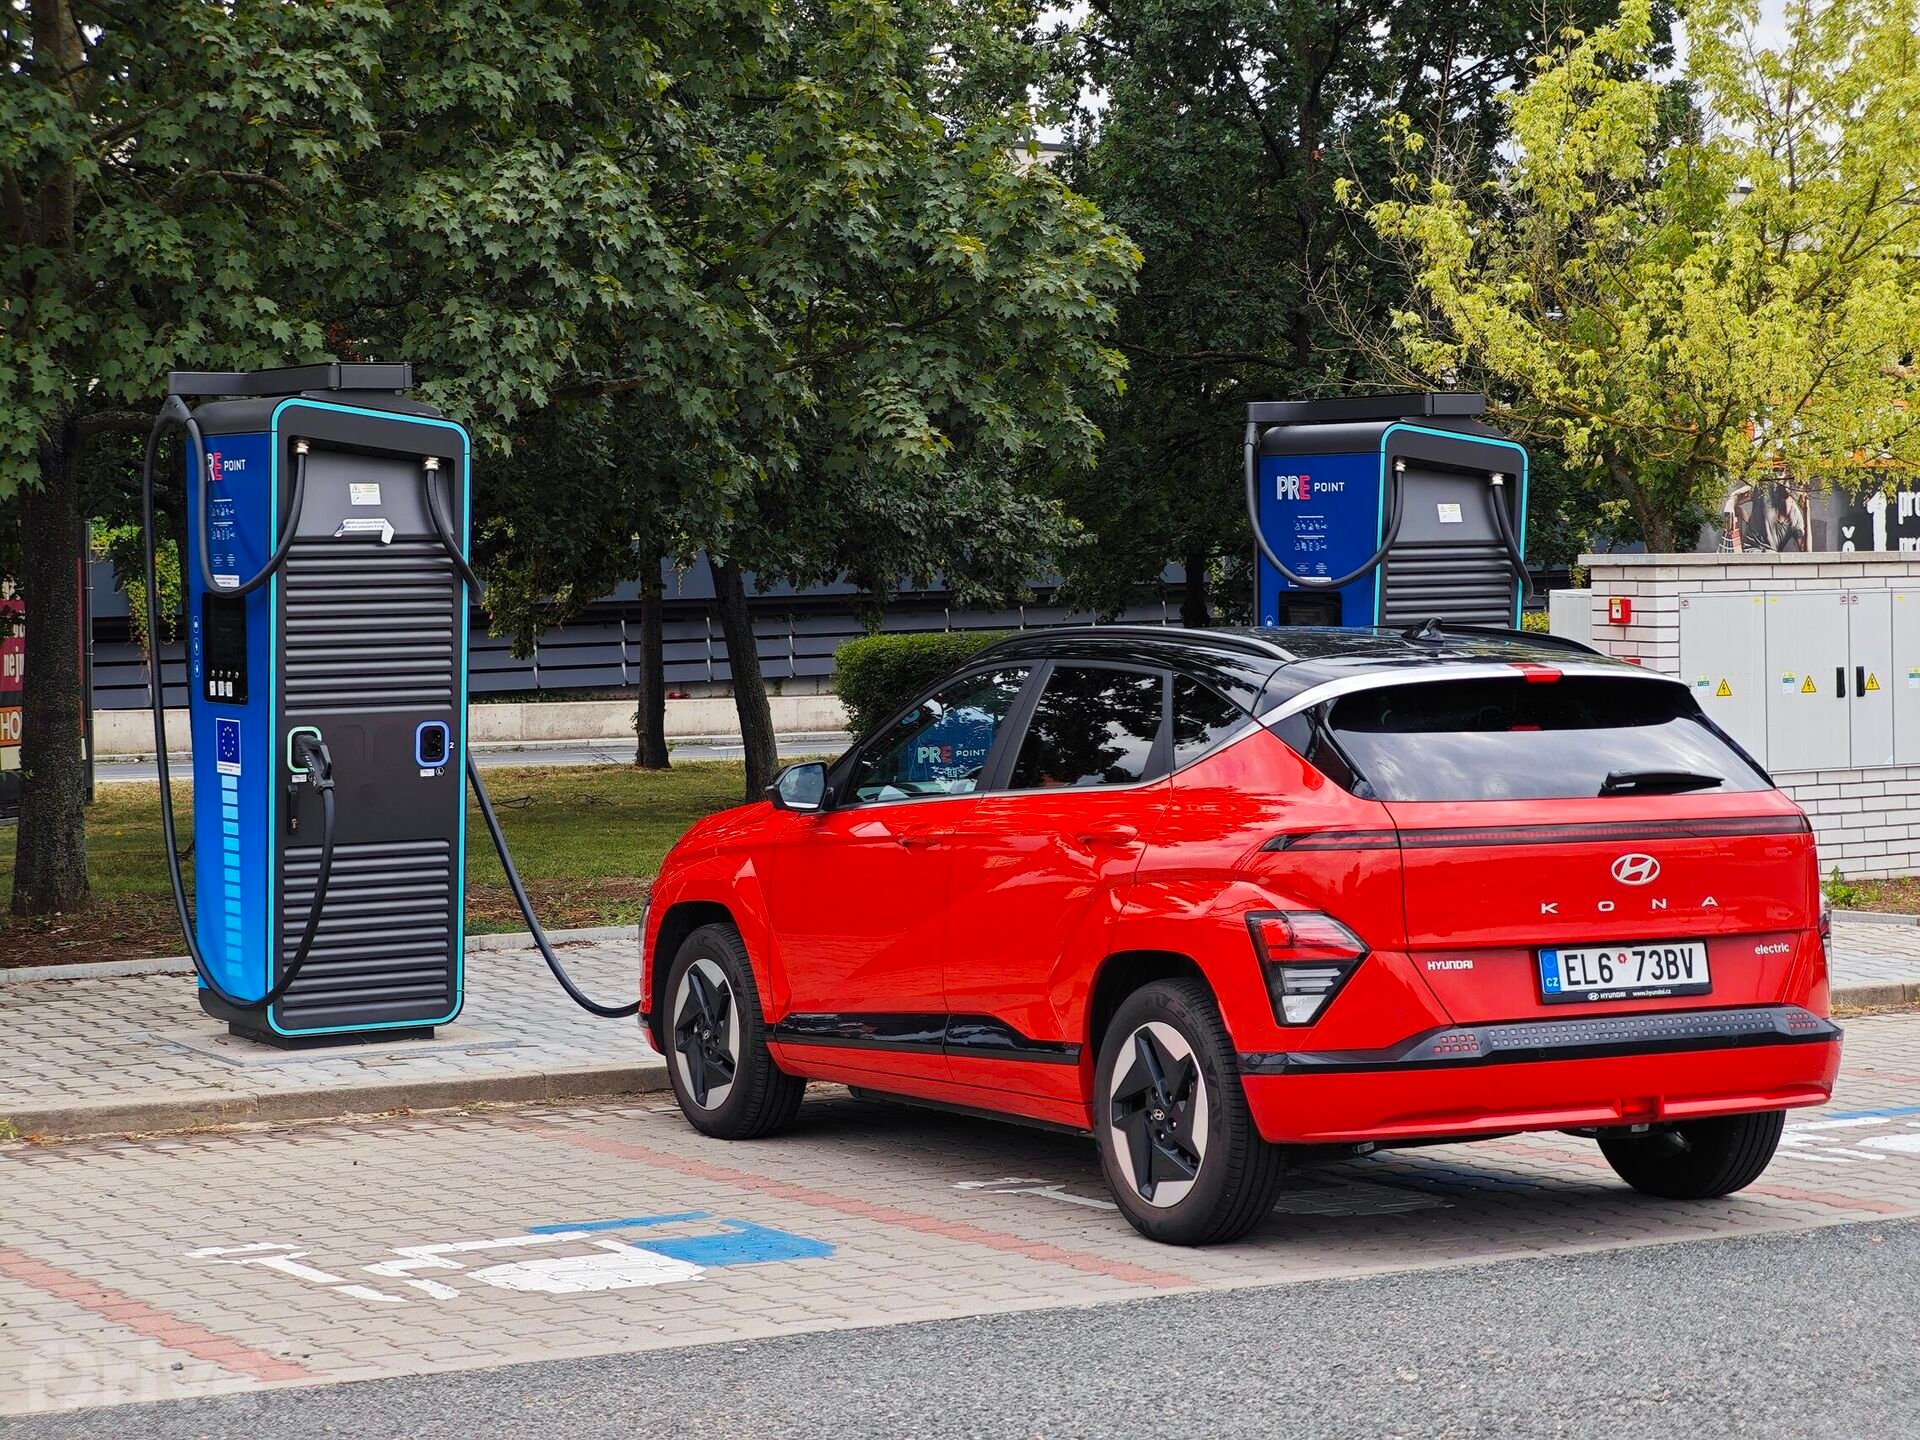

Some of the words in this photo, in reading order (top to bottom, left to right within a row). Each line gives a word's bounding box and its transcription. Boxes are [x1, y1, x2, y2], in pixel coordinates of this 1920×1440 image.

[206, 453, 223, 481] RE
[224, 459, 246, 471] POINT
[1276, 475, 1311, 500] PRE
[1314, 482, 1345, 492] POINT
[449, 741, 455, 749] 2
[918, 745, 952, 764] PRE
[956, 749, 986, 757] POINT
[1541, 896, 1719, 914] KONA
[1755, 942, 1790, 955] electric
[1427, 960, 1474, 971] HYUNDAI
[1564, 953, 1613, 986] EL6
[1632, 948, 1693, 982] 73BV
[1546, 977, 1559, 987] CZ
